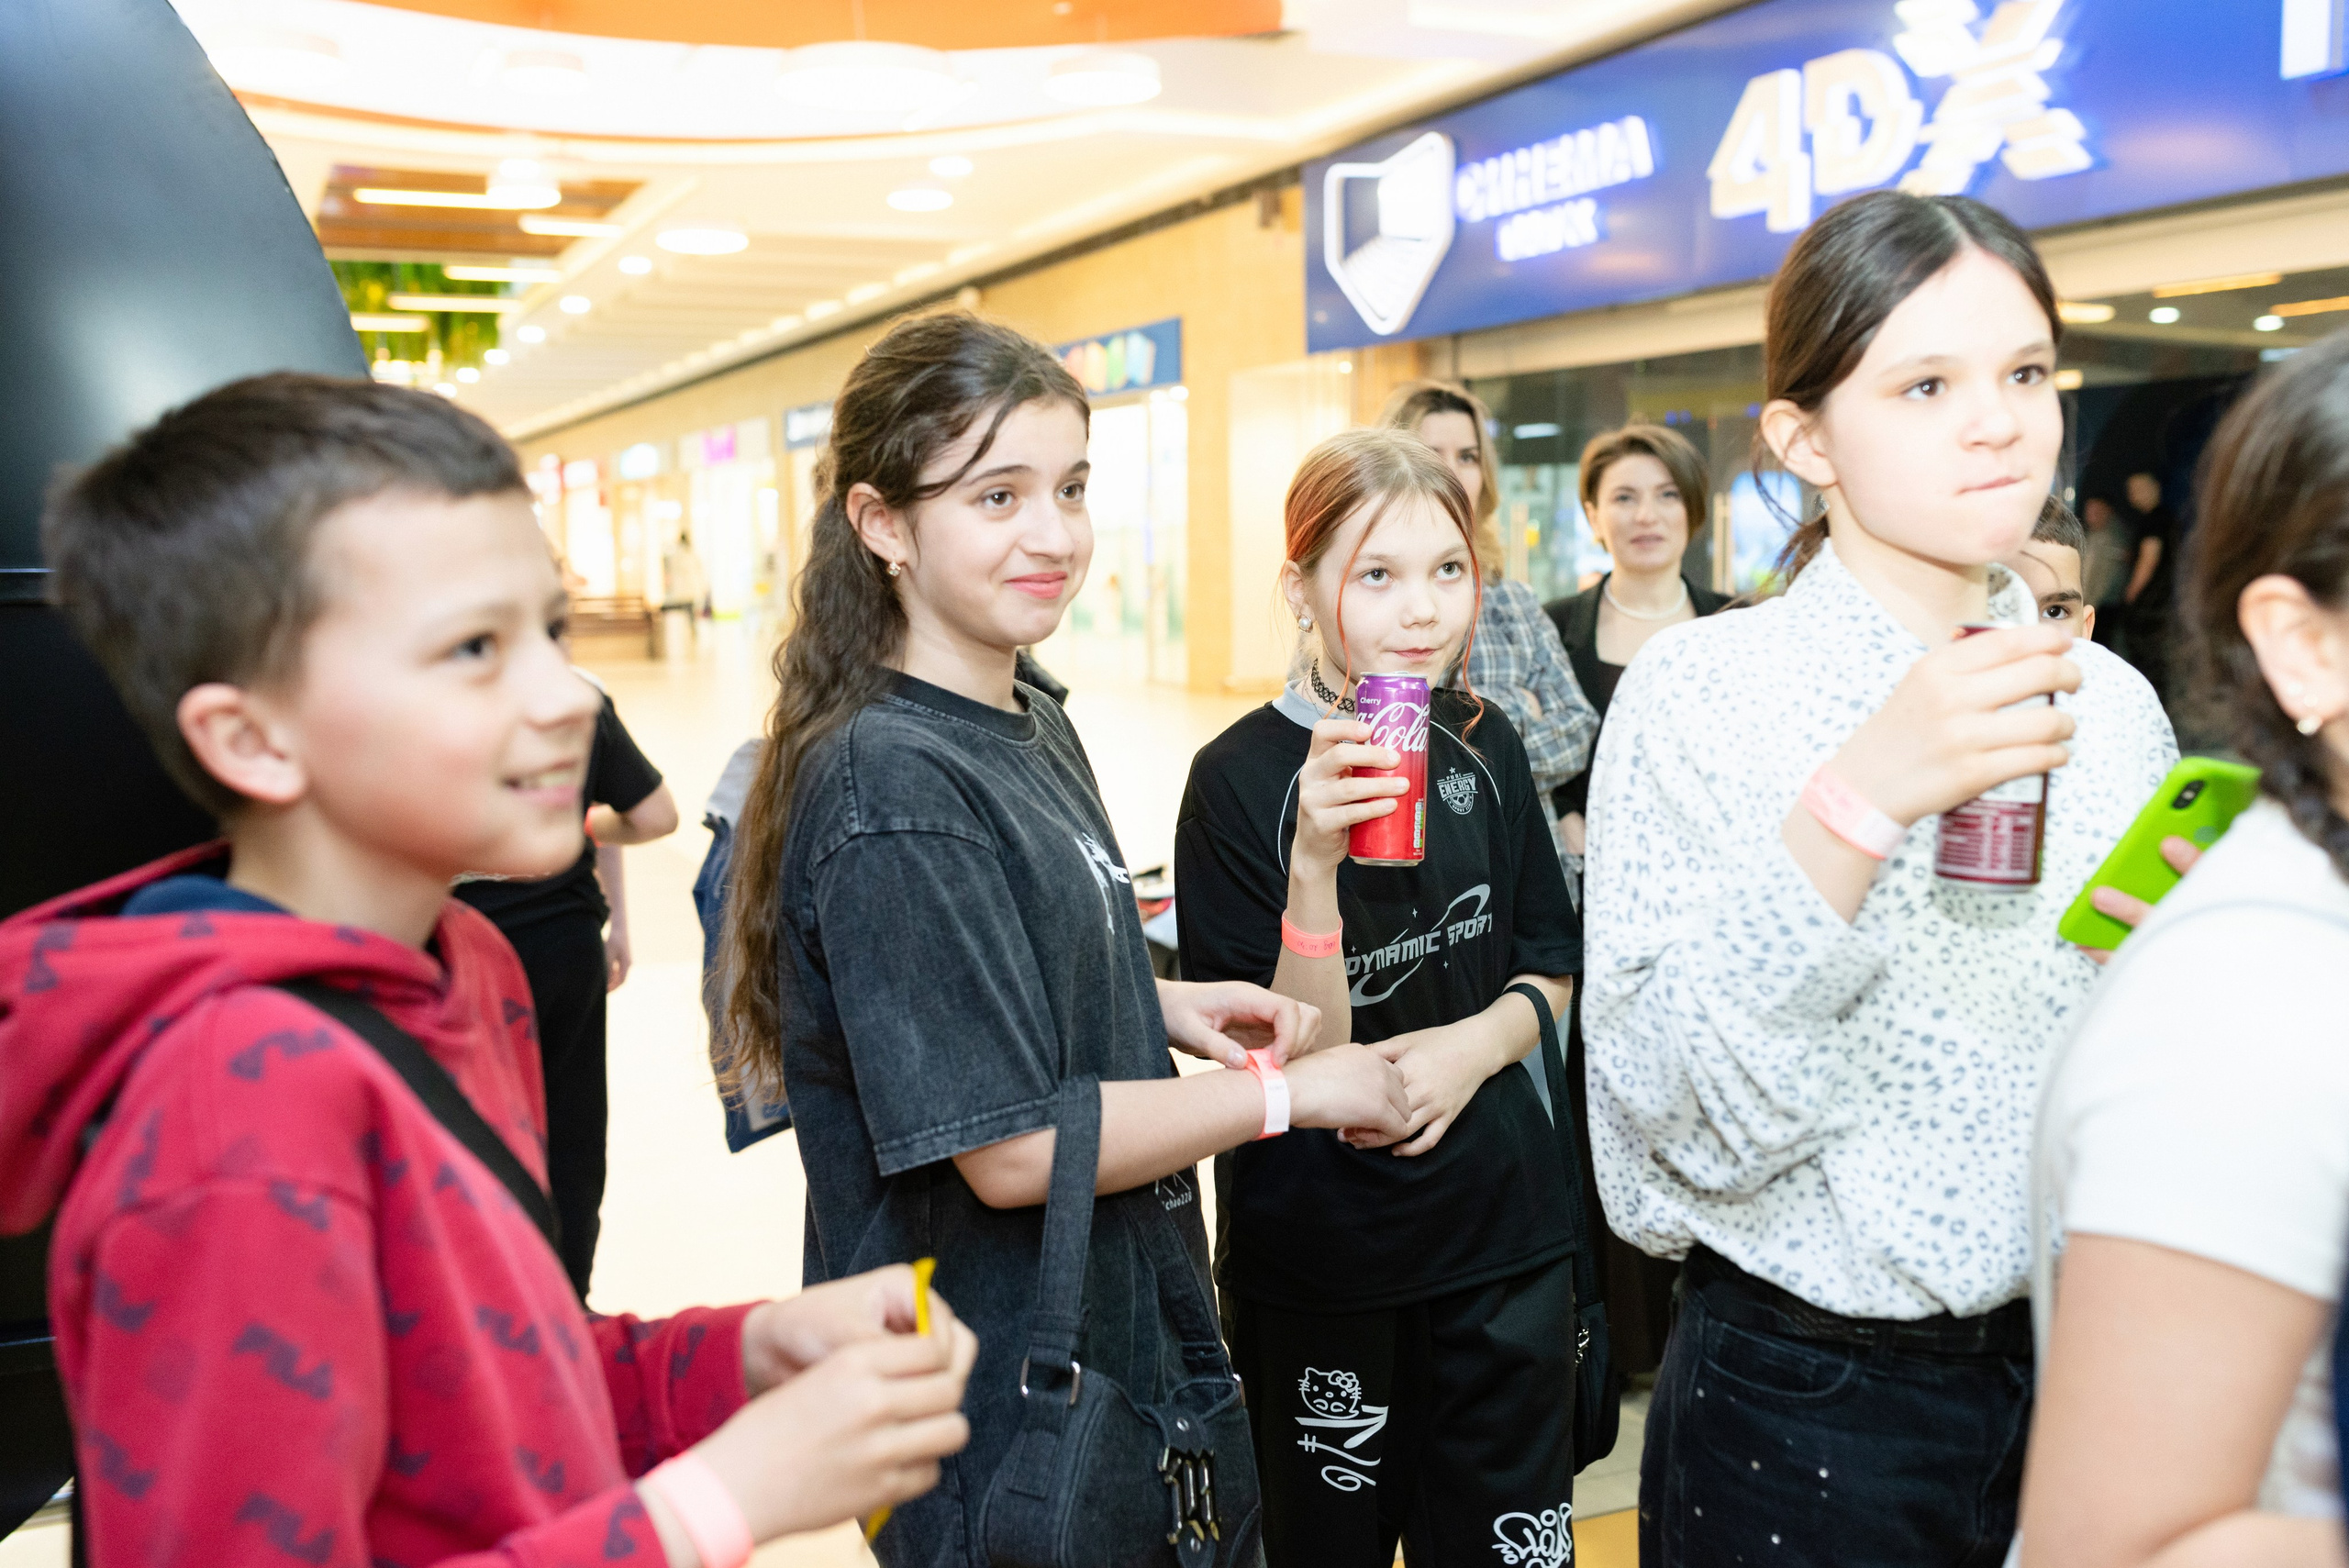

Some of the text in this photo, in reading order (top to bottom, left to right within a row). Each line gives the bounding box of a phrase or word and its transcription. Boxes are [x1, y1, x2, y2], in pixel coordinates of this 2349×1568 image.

[1360, 697, 1382, 706] Cherry
[1438, 776, 1476, 798] ENERGY
[1344, 912, 1493, 976] DYNAMIC SPORT
